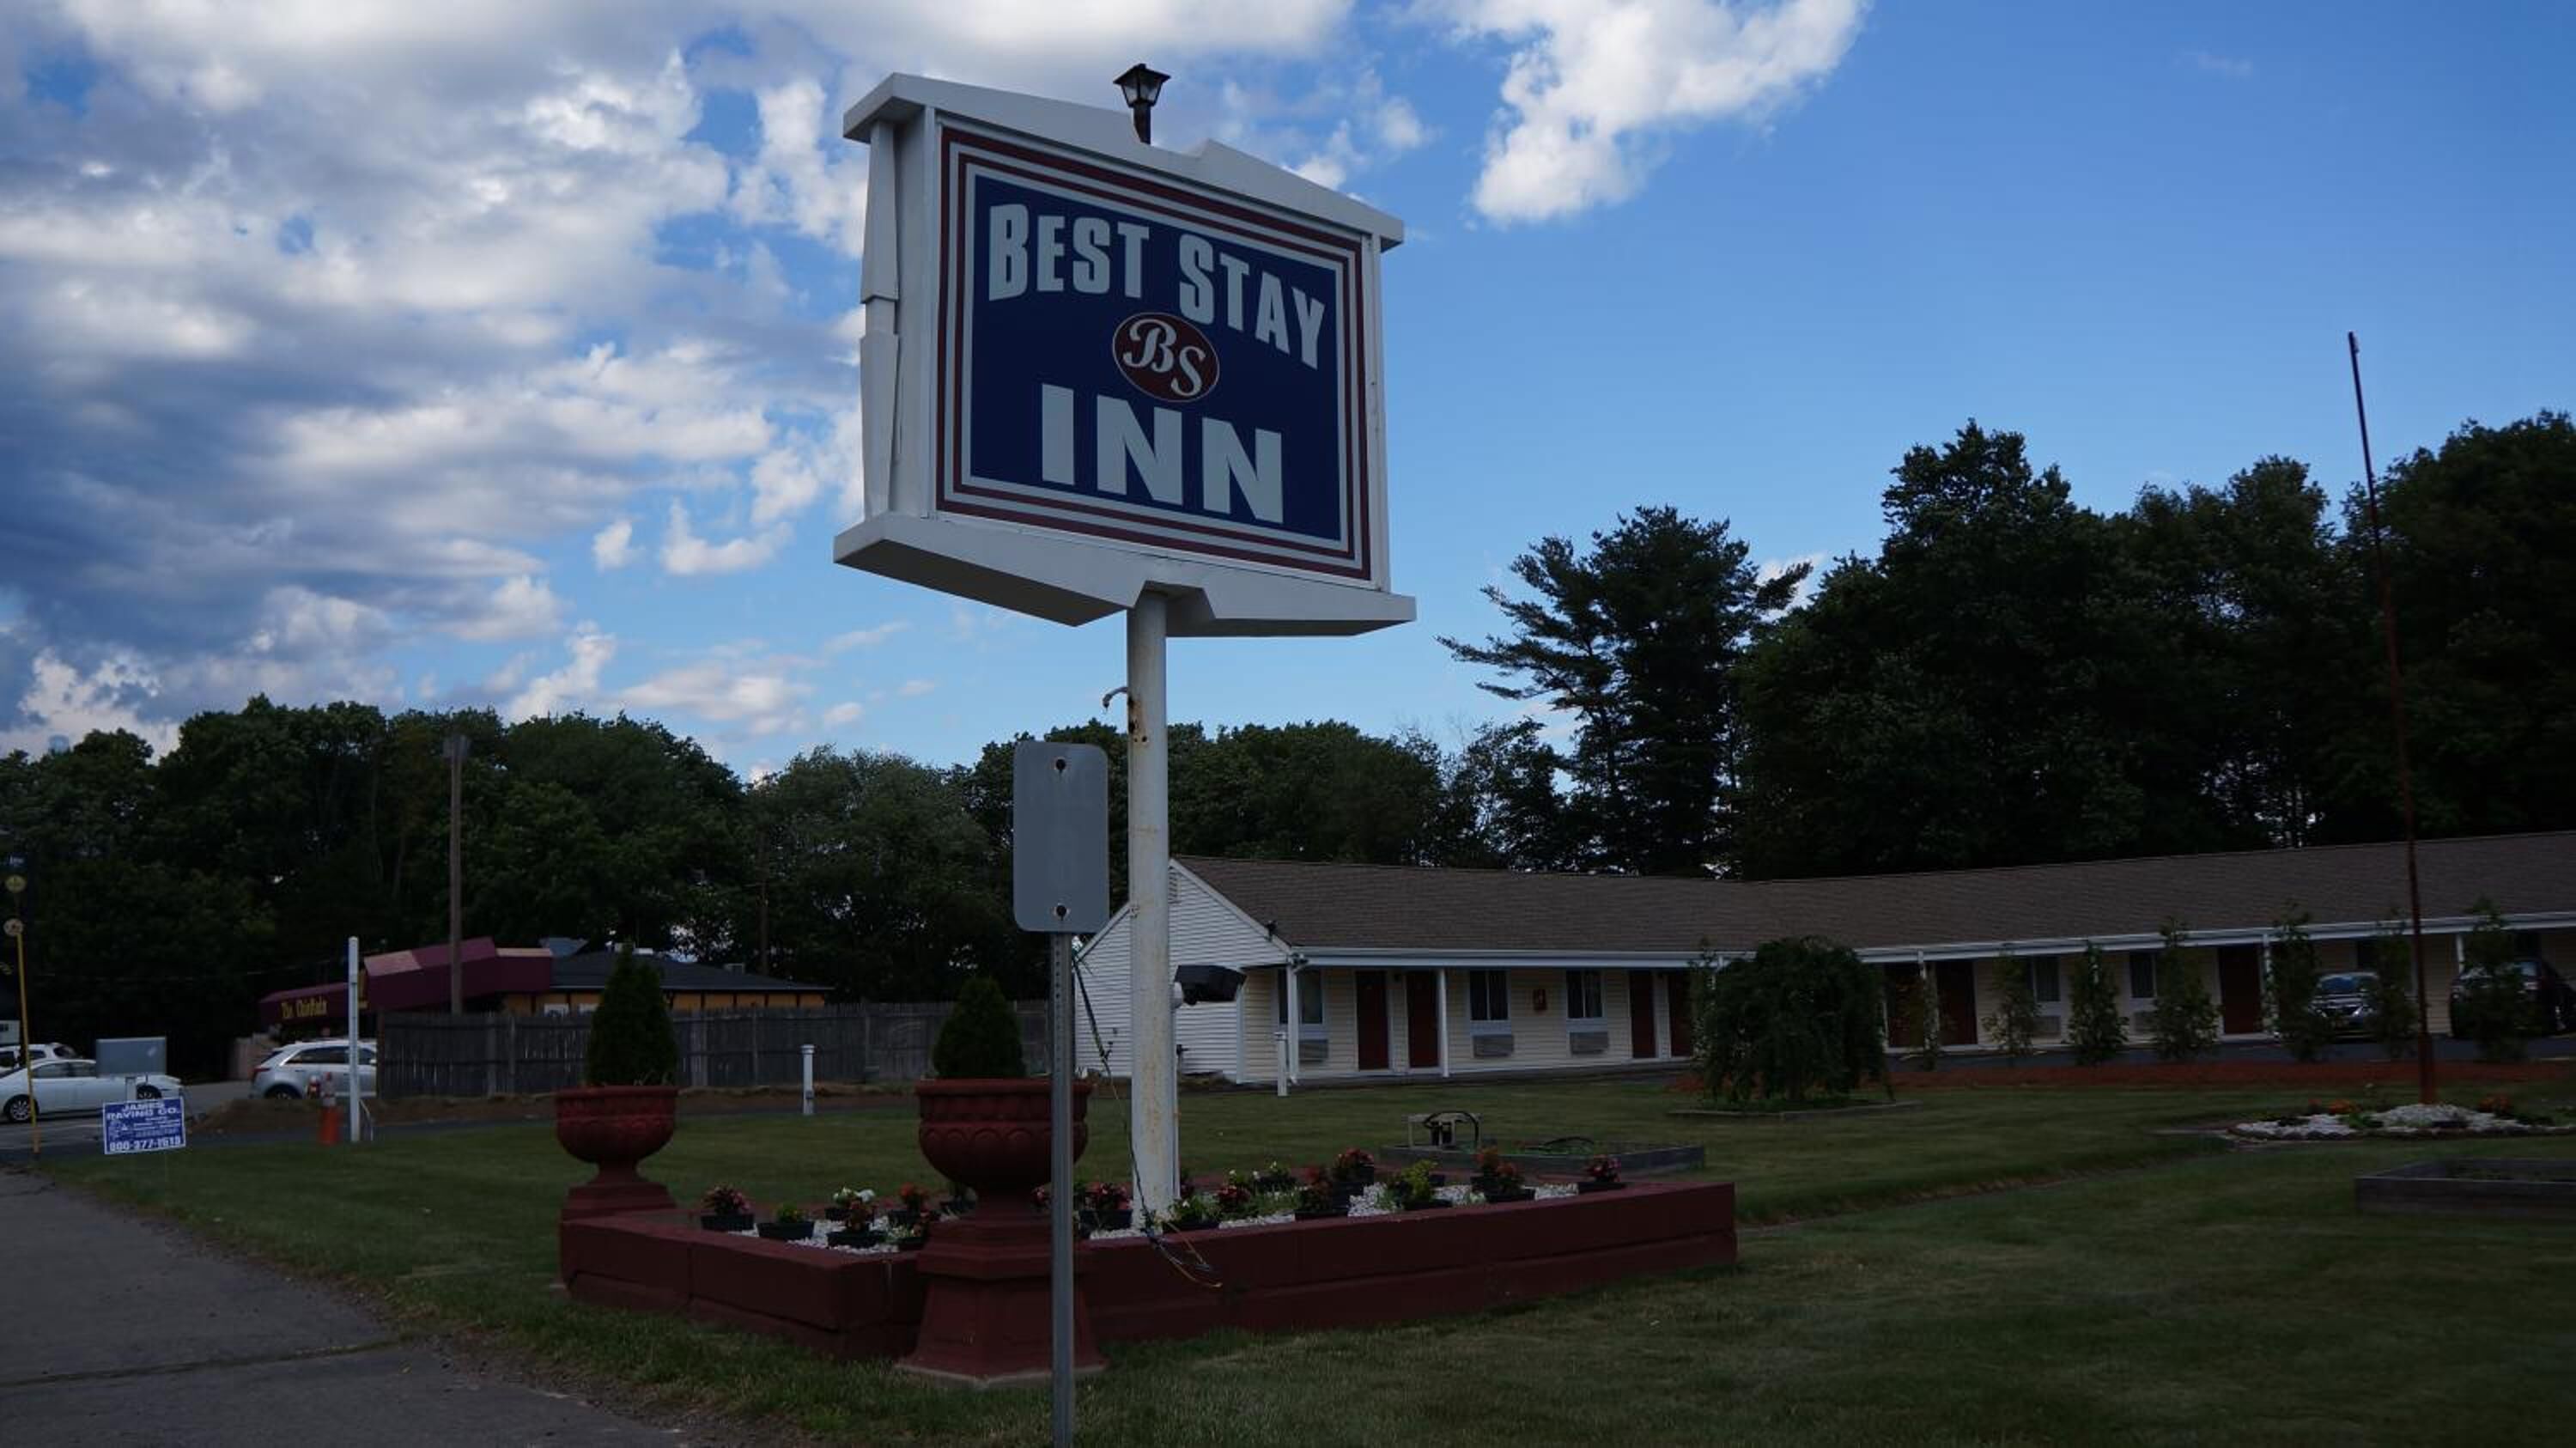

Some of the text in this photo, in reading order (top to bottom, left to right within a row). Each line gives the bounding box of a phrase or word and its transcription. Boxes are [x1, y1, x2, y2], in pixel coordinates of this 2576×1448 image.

[988, 204, 1326, 371] BEST STAY
[1122, 318, 1206, 398] BS
[1041, 382, 1284, 524] INN
